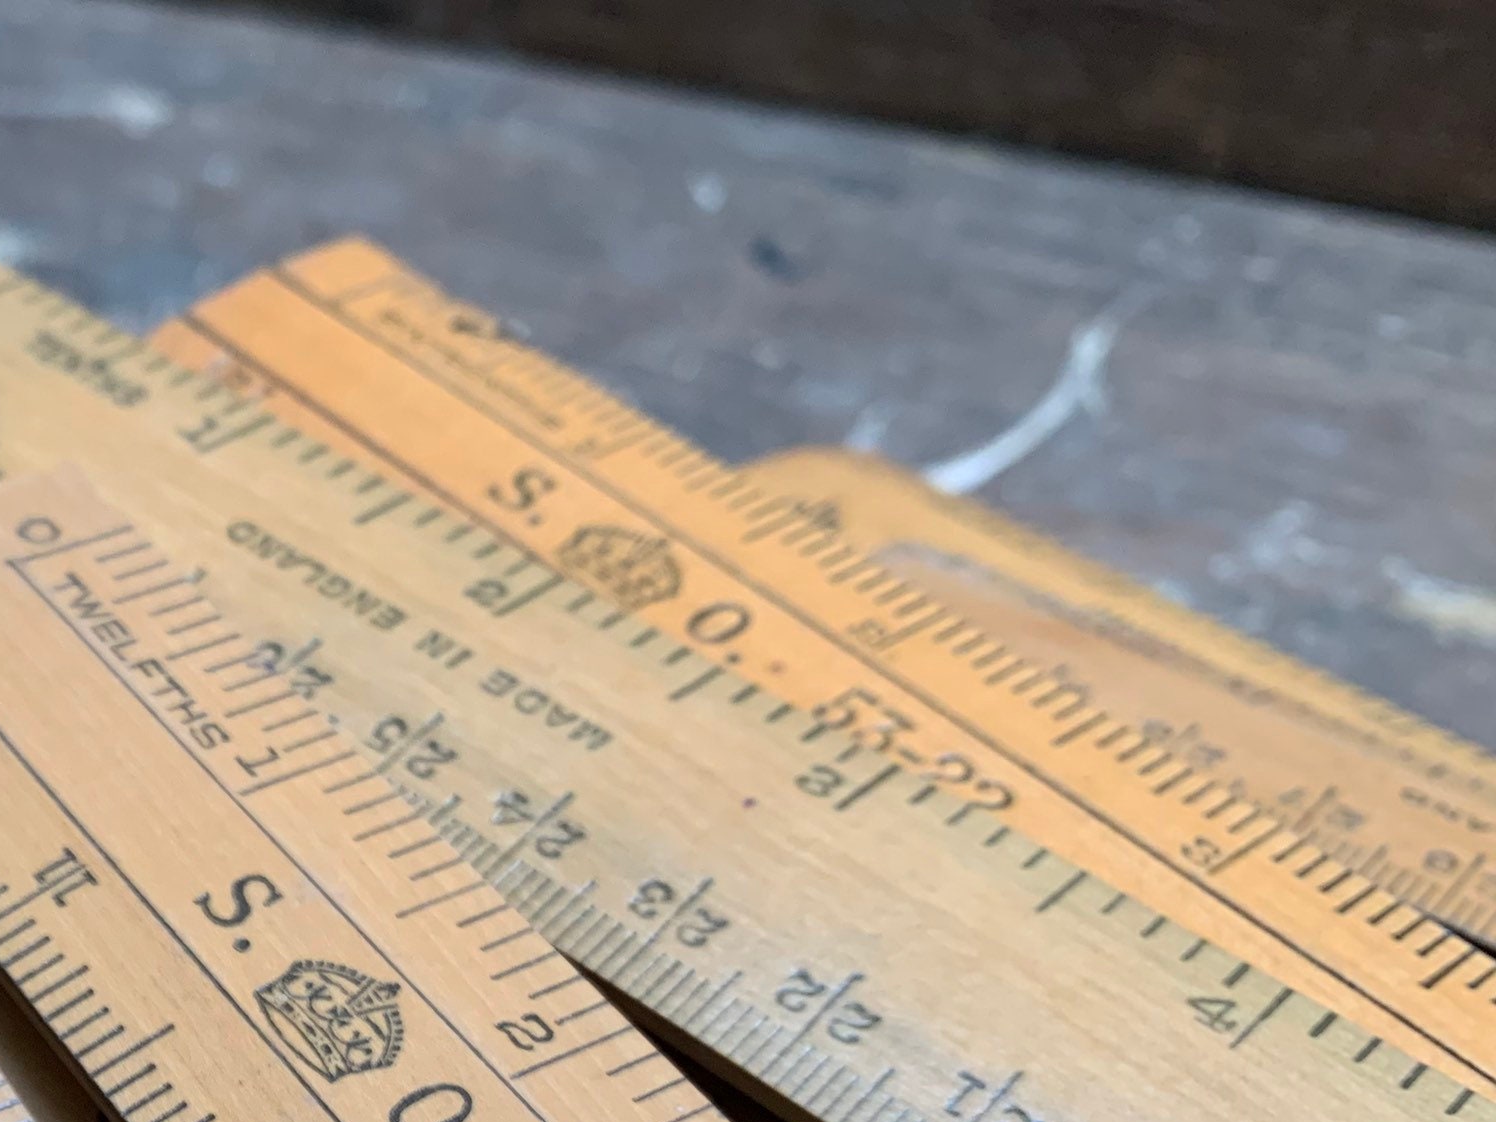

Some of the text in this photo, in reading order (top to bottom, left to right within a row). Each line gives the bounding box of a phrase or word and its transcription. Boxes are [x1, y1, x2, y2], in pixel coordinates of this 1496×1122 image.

[461, 577, 510, 610] 2
[487, 467, 558, 527] S.
[686, 602, 752, 665] O.
[47, 571, 231, 752] TWELFTHS
[225, 518, 614, 752] MADE IN ENGLAND
[366, 714, 458, 779] 25
[192, 873, 283, 954] S.
[627, 878, 730, 949] 23
[494, 1012, 554, 1051] 2
[775, 967, 881, 1045] 22
[1187, 995, 1237, 1035] 4
